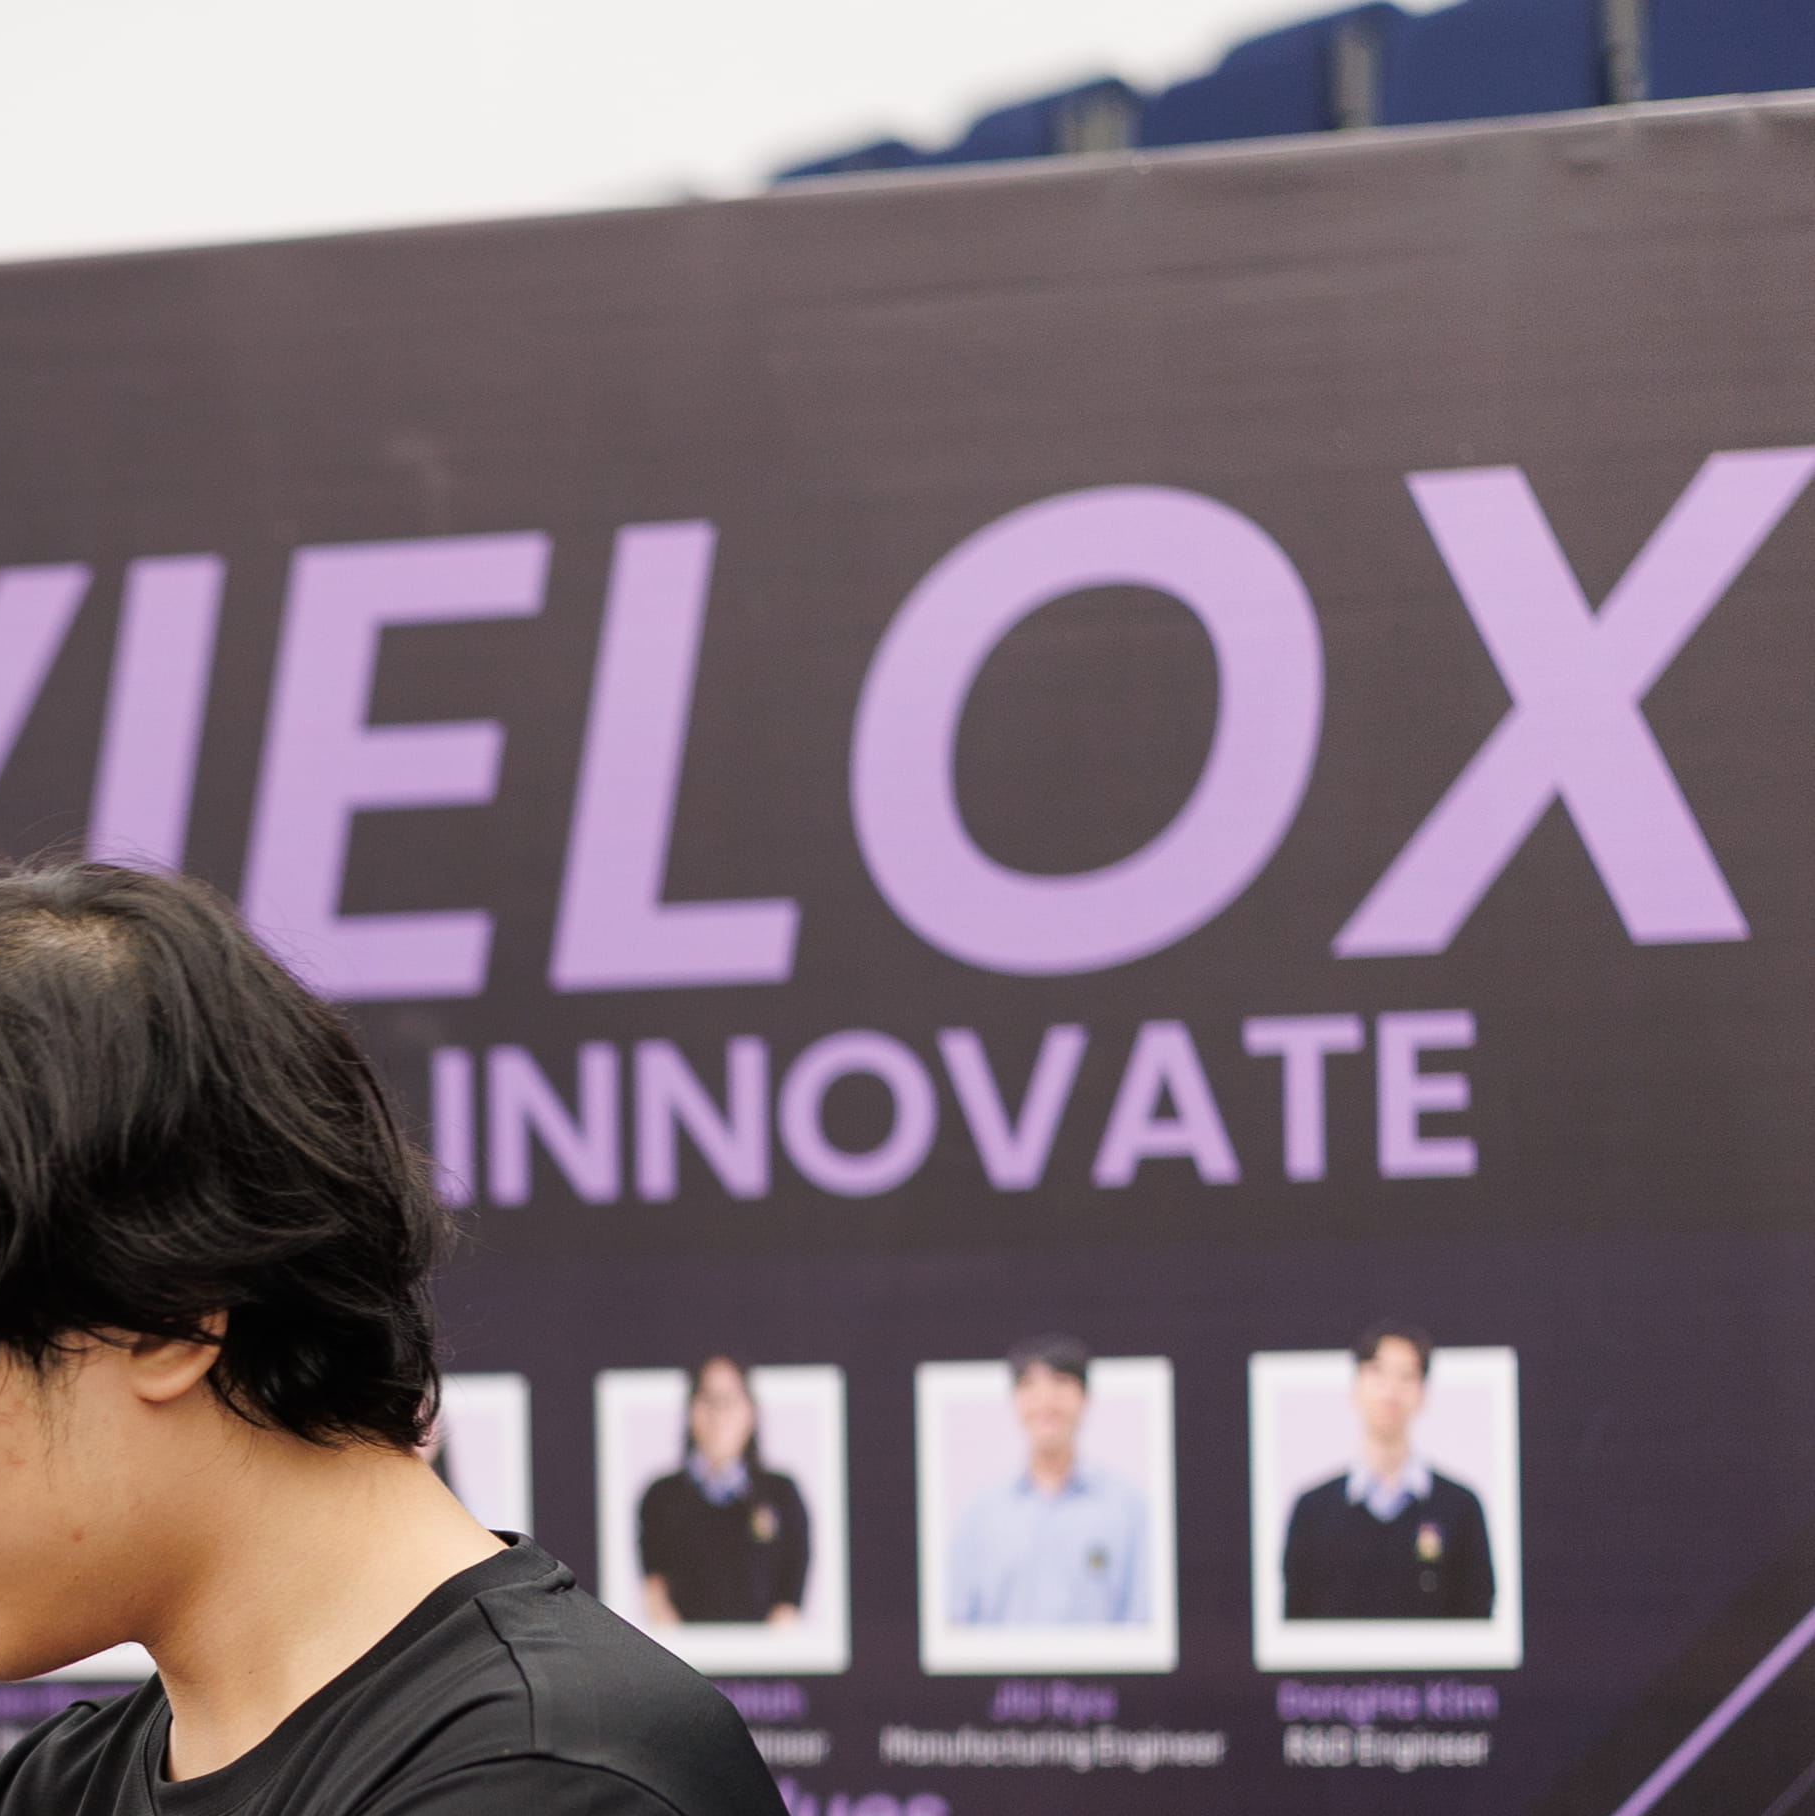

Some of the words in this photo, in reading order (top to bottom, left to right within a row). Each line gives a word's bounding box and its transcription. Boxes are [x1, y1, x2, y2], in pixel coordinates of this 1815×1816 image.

[431, 1009, 1479, 1210] INNOVATE
[1092, 1724, 1226, 1773] Engineer
[1355, 1725, 1489, 1773] Engineer
